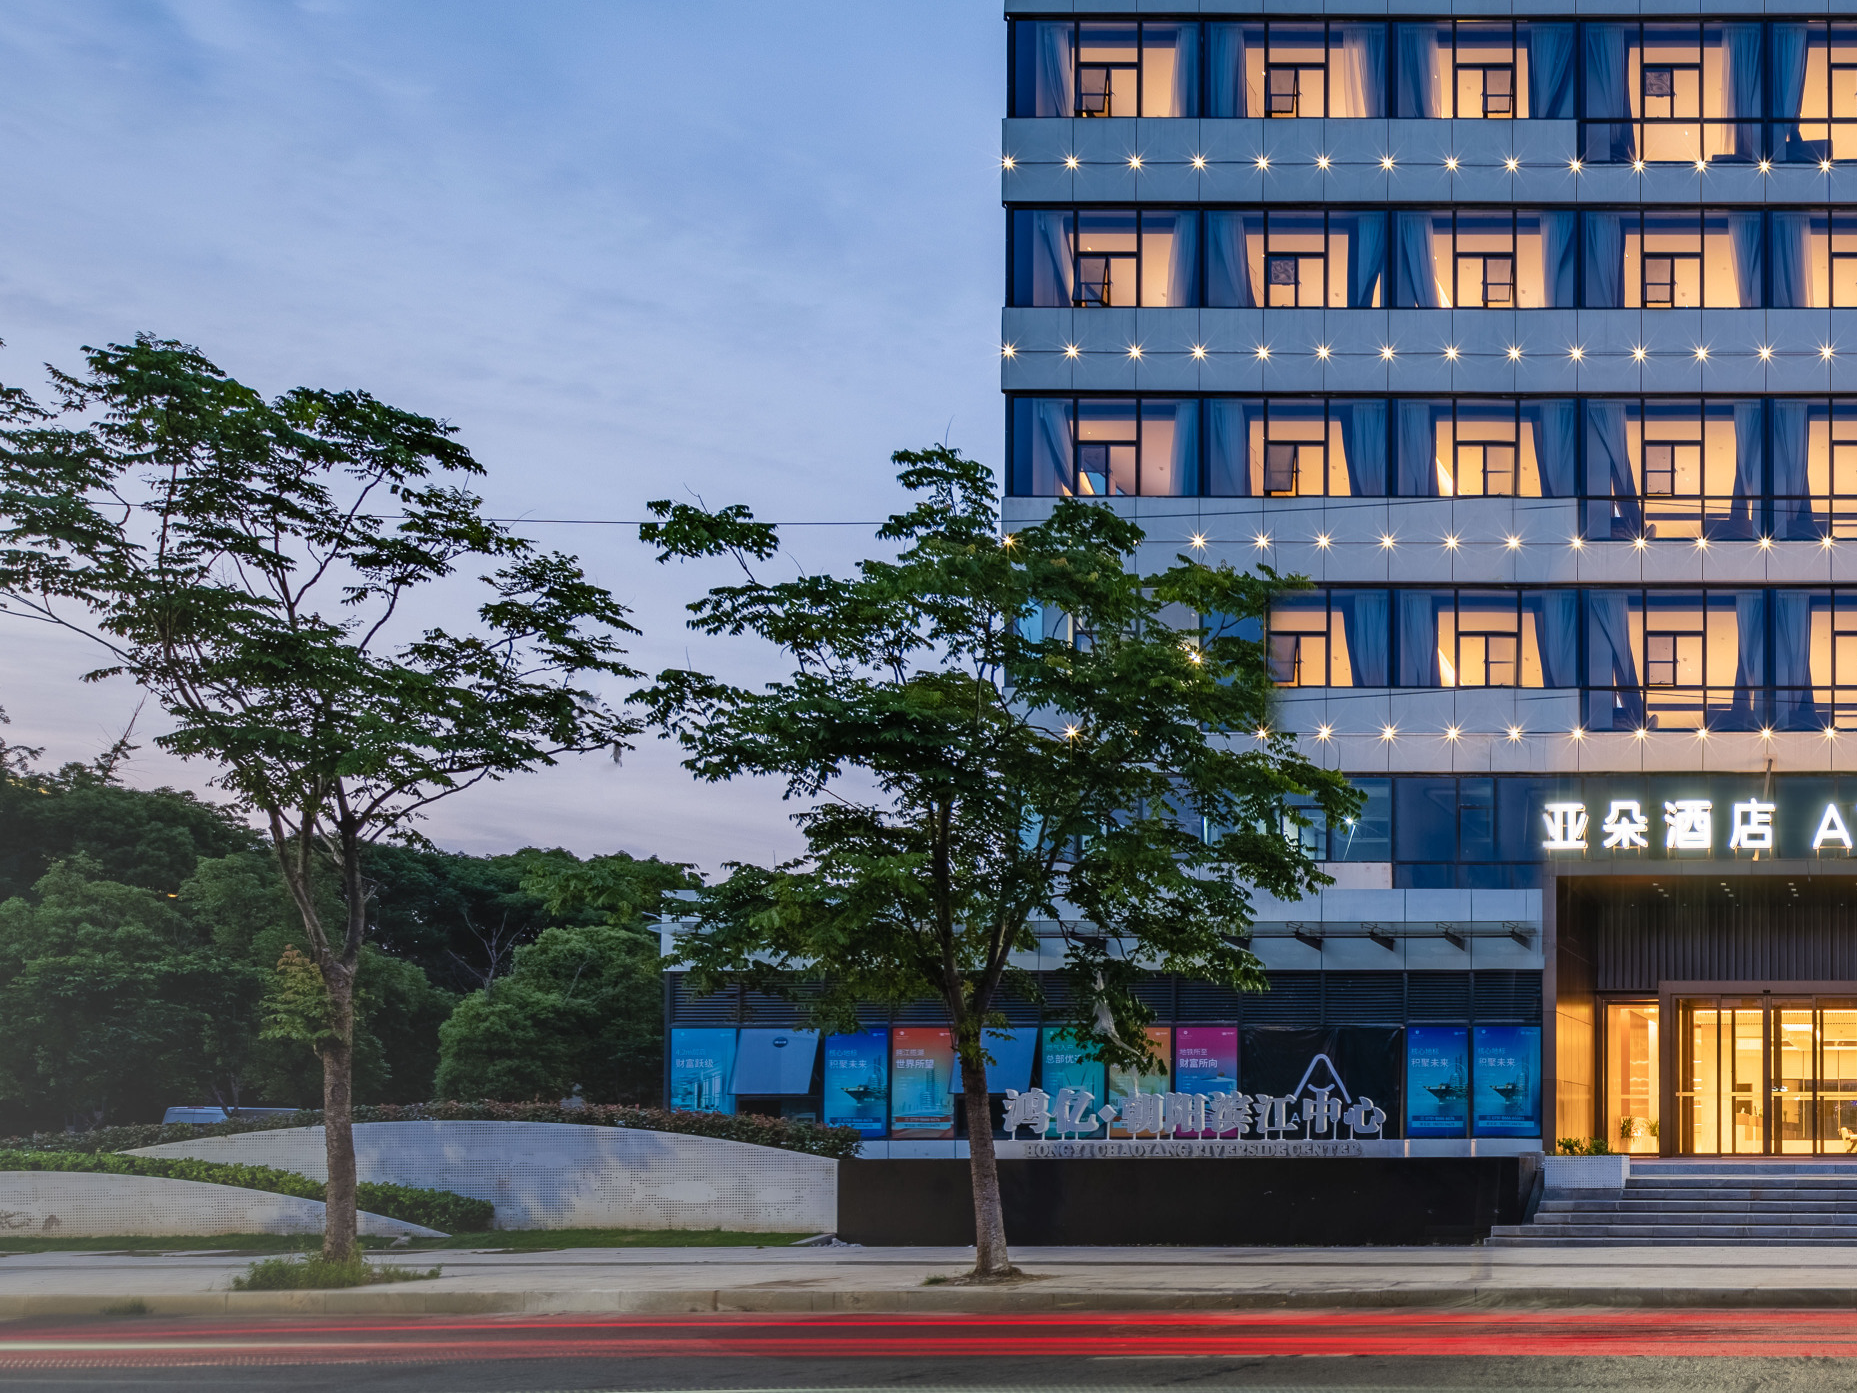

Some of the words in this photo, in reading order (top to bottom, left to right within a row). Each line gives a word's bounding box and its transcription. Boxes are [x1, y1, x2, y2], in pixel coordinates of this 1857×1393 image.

[1542, 797, 1776, 850] 亚朵酒店
[1179, 1048, 1208, 1056] 地铁所至
[829, 1059, 867, 1069] 积聚未来
[895, 1059, 935, 1069] 世界所望
[1179, 1058, 1218, 1069] 财富所向
[1411, 1058, 1449, 1068] 积聚未来
[1479, 1057, 1516, 1067] 积聚未来
[1026, 1142, 1091, 1157] HONGYI
[1095, 1142, 1193, 1157] CHAOYANG
[1196, 1142, 1288, 1157] RIVERSIDE
[1290, 1142, 1362, 1157] CENTER
